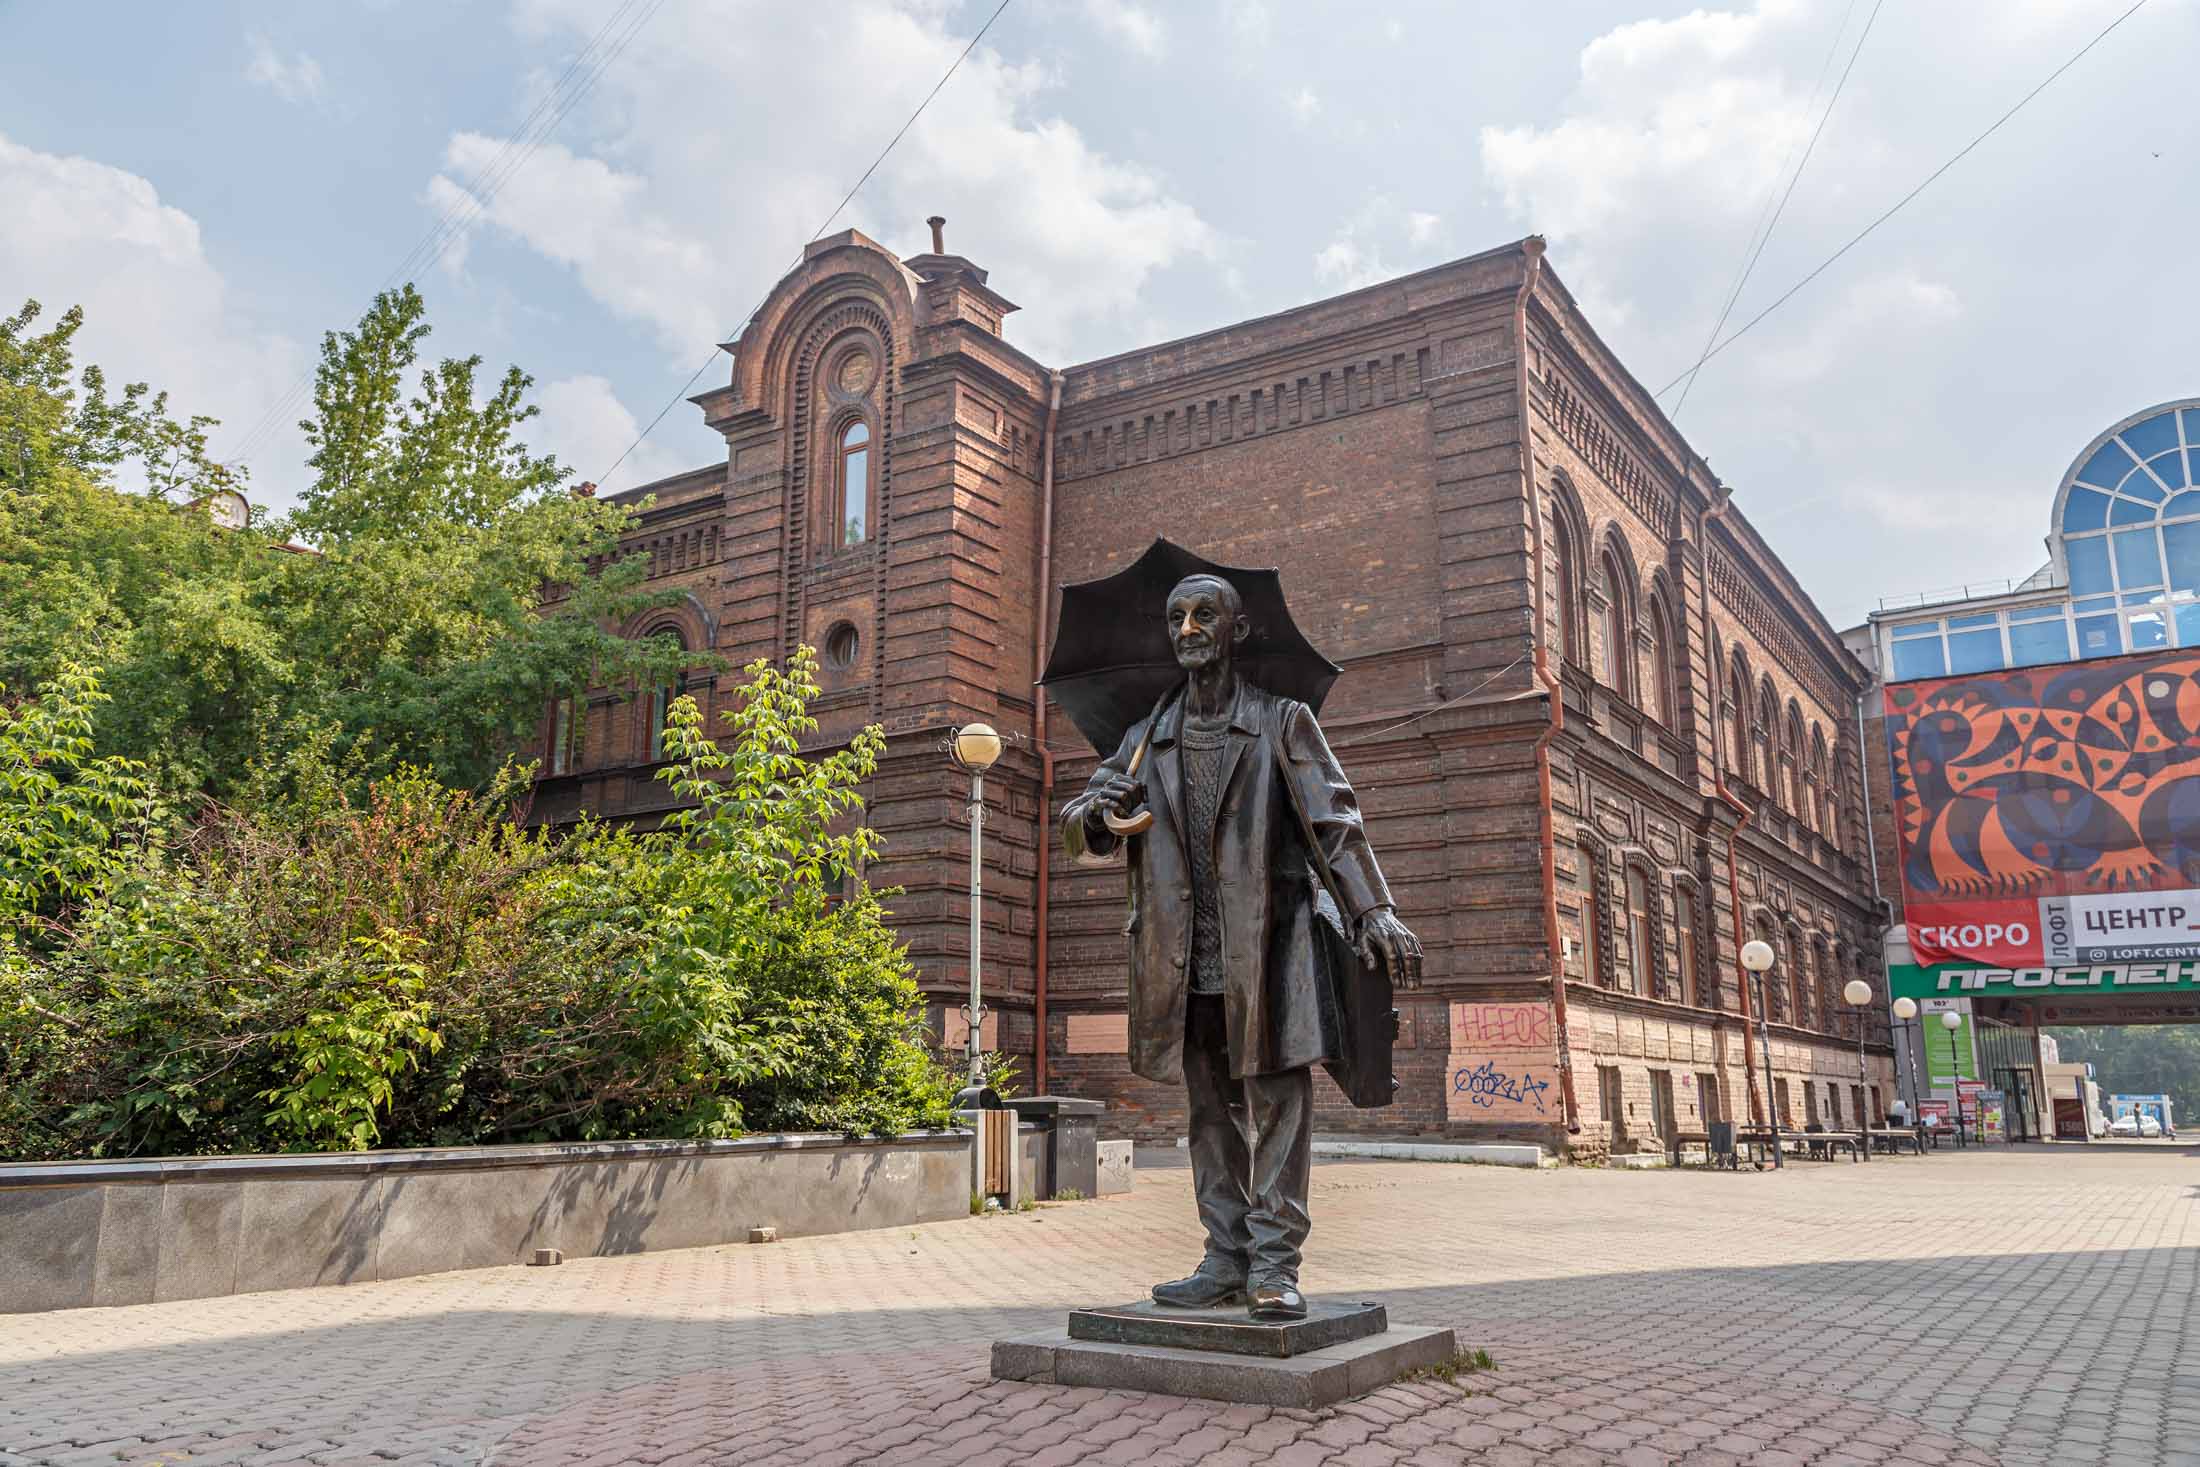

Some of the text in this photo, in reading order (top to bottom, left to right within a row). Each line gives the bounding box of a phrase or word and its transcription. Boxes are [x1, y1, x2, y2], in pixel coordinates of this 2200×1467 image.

[2048, 904, 2070, 958] ЛОФТ
[2085, 907, 2186, 934] ЦЕНТР
[1919, 923, 2030, 948] СКОРО
